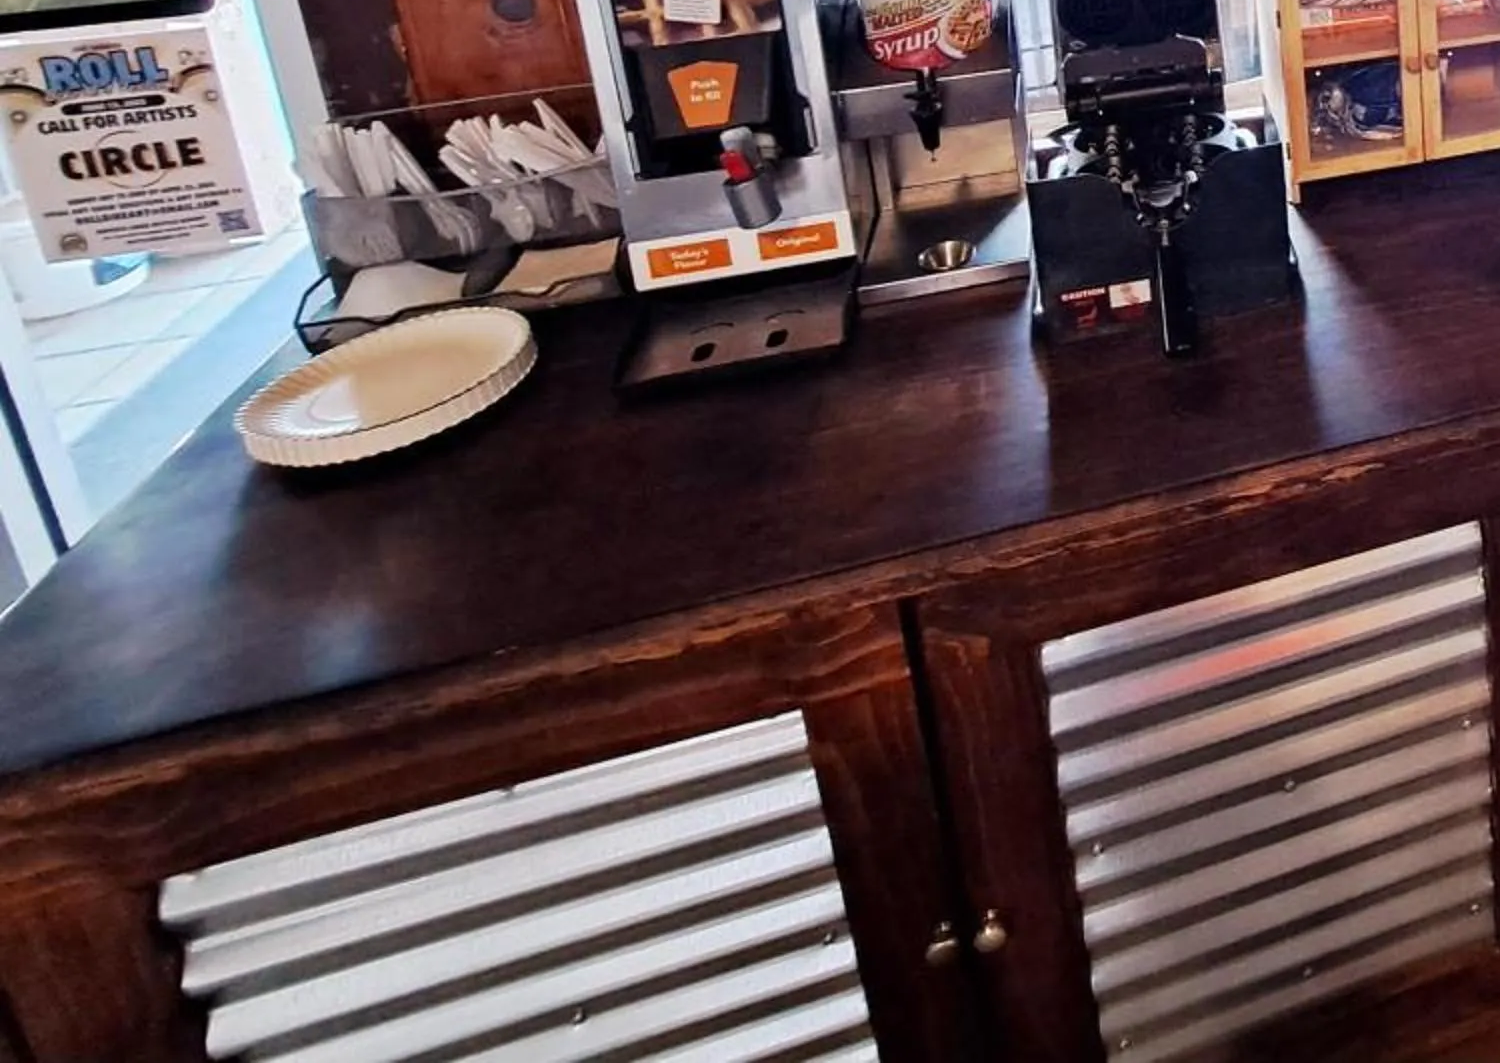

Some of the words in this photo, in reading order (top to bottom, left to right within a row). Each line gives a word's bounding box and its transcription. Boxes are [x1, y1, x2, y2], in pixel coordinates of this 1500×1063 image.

[39, 46, 169, 94] ROLL
[38, 116, 80, 135] CALL
[83, 112, 119, 131] FOR
[124, 104, 198, 126] ARTISTS
[58, 137, 206, 180] CIRCLE
